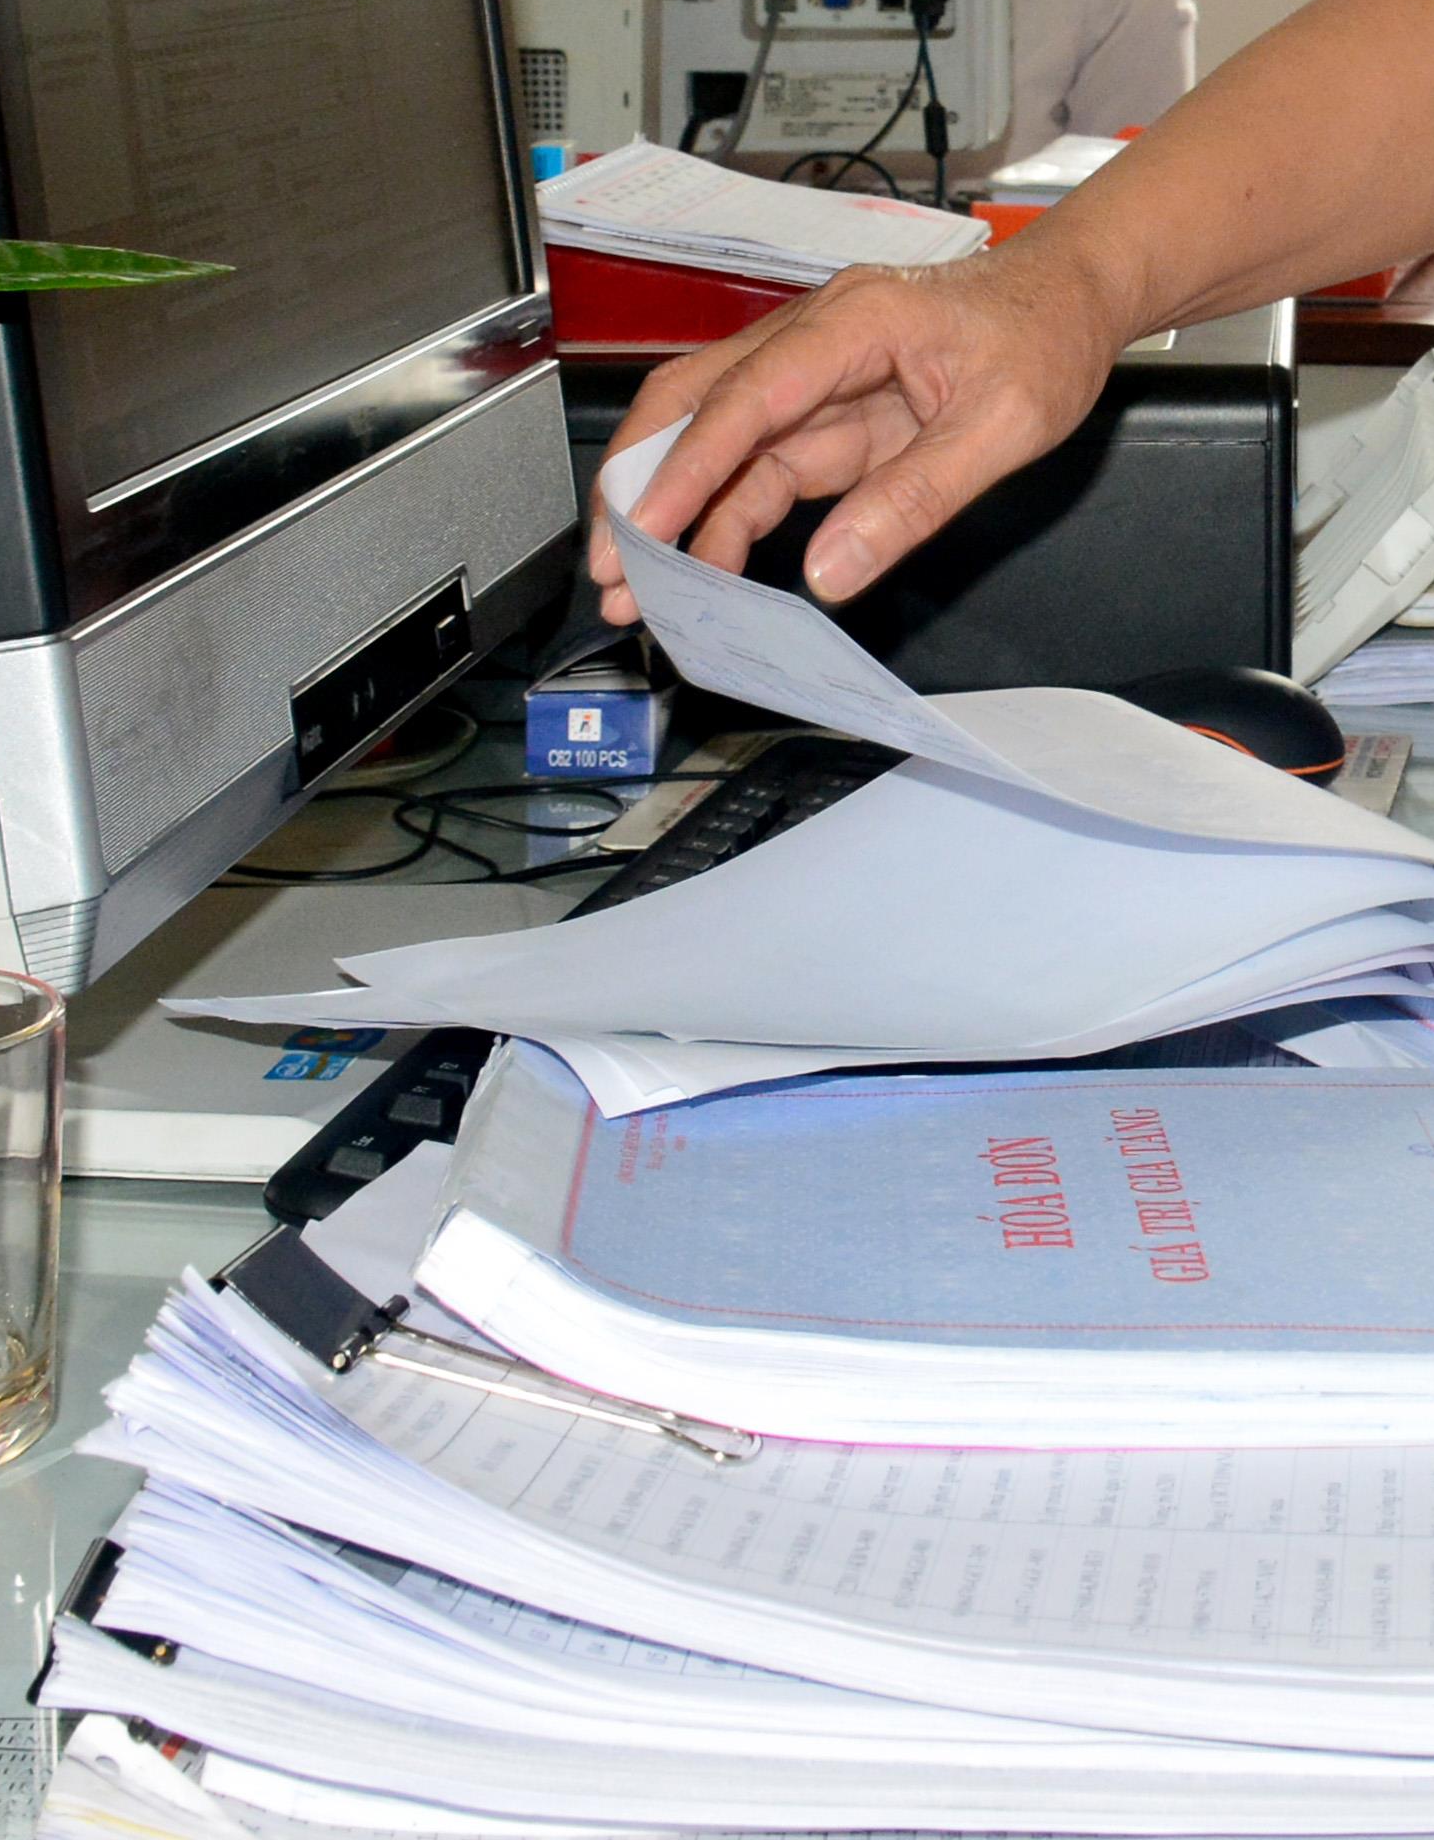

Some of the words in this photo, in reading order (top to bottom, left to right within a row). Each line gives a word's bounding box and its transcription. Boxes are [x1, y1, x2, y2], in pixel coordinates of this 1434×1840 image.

[576, 749, 597, 767] 100
[599, 749, 628, 767] PCS
[1103, 1107, 1172, 1157] TĂNG
[975, 1134, 1062, 1188] ĐƠN
[1124, 1159, 1184, 1194] GIA
[975, 1191, 1076, 1250] HÓA
[1134, 1198, 1202, 1236] TRỊ
[1127, 1240, 1208, 1284] GIÁ
